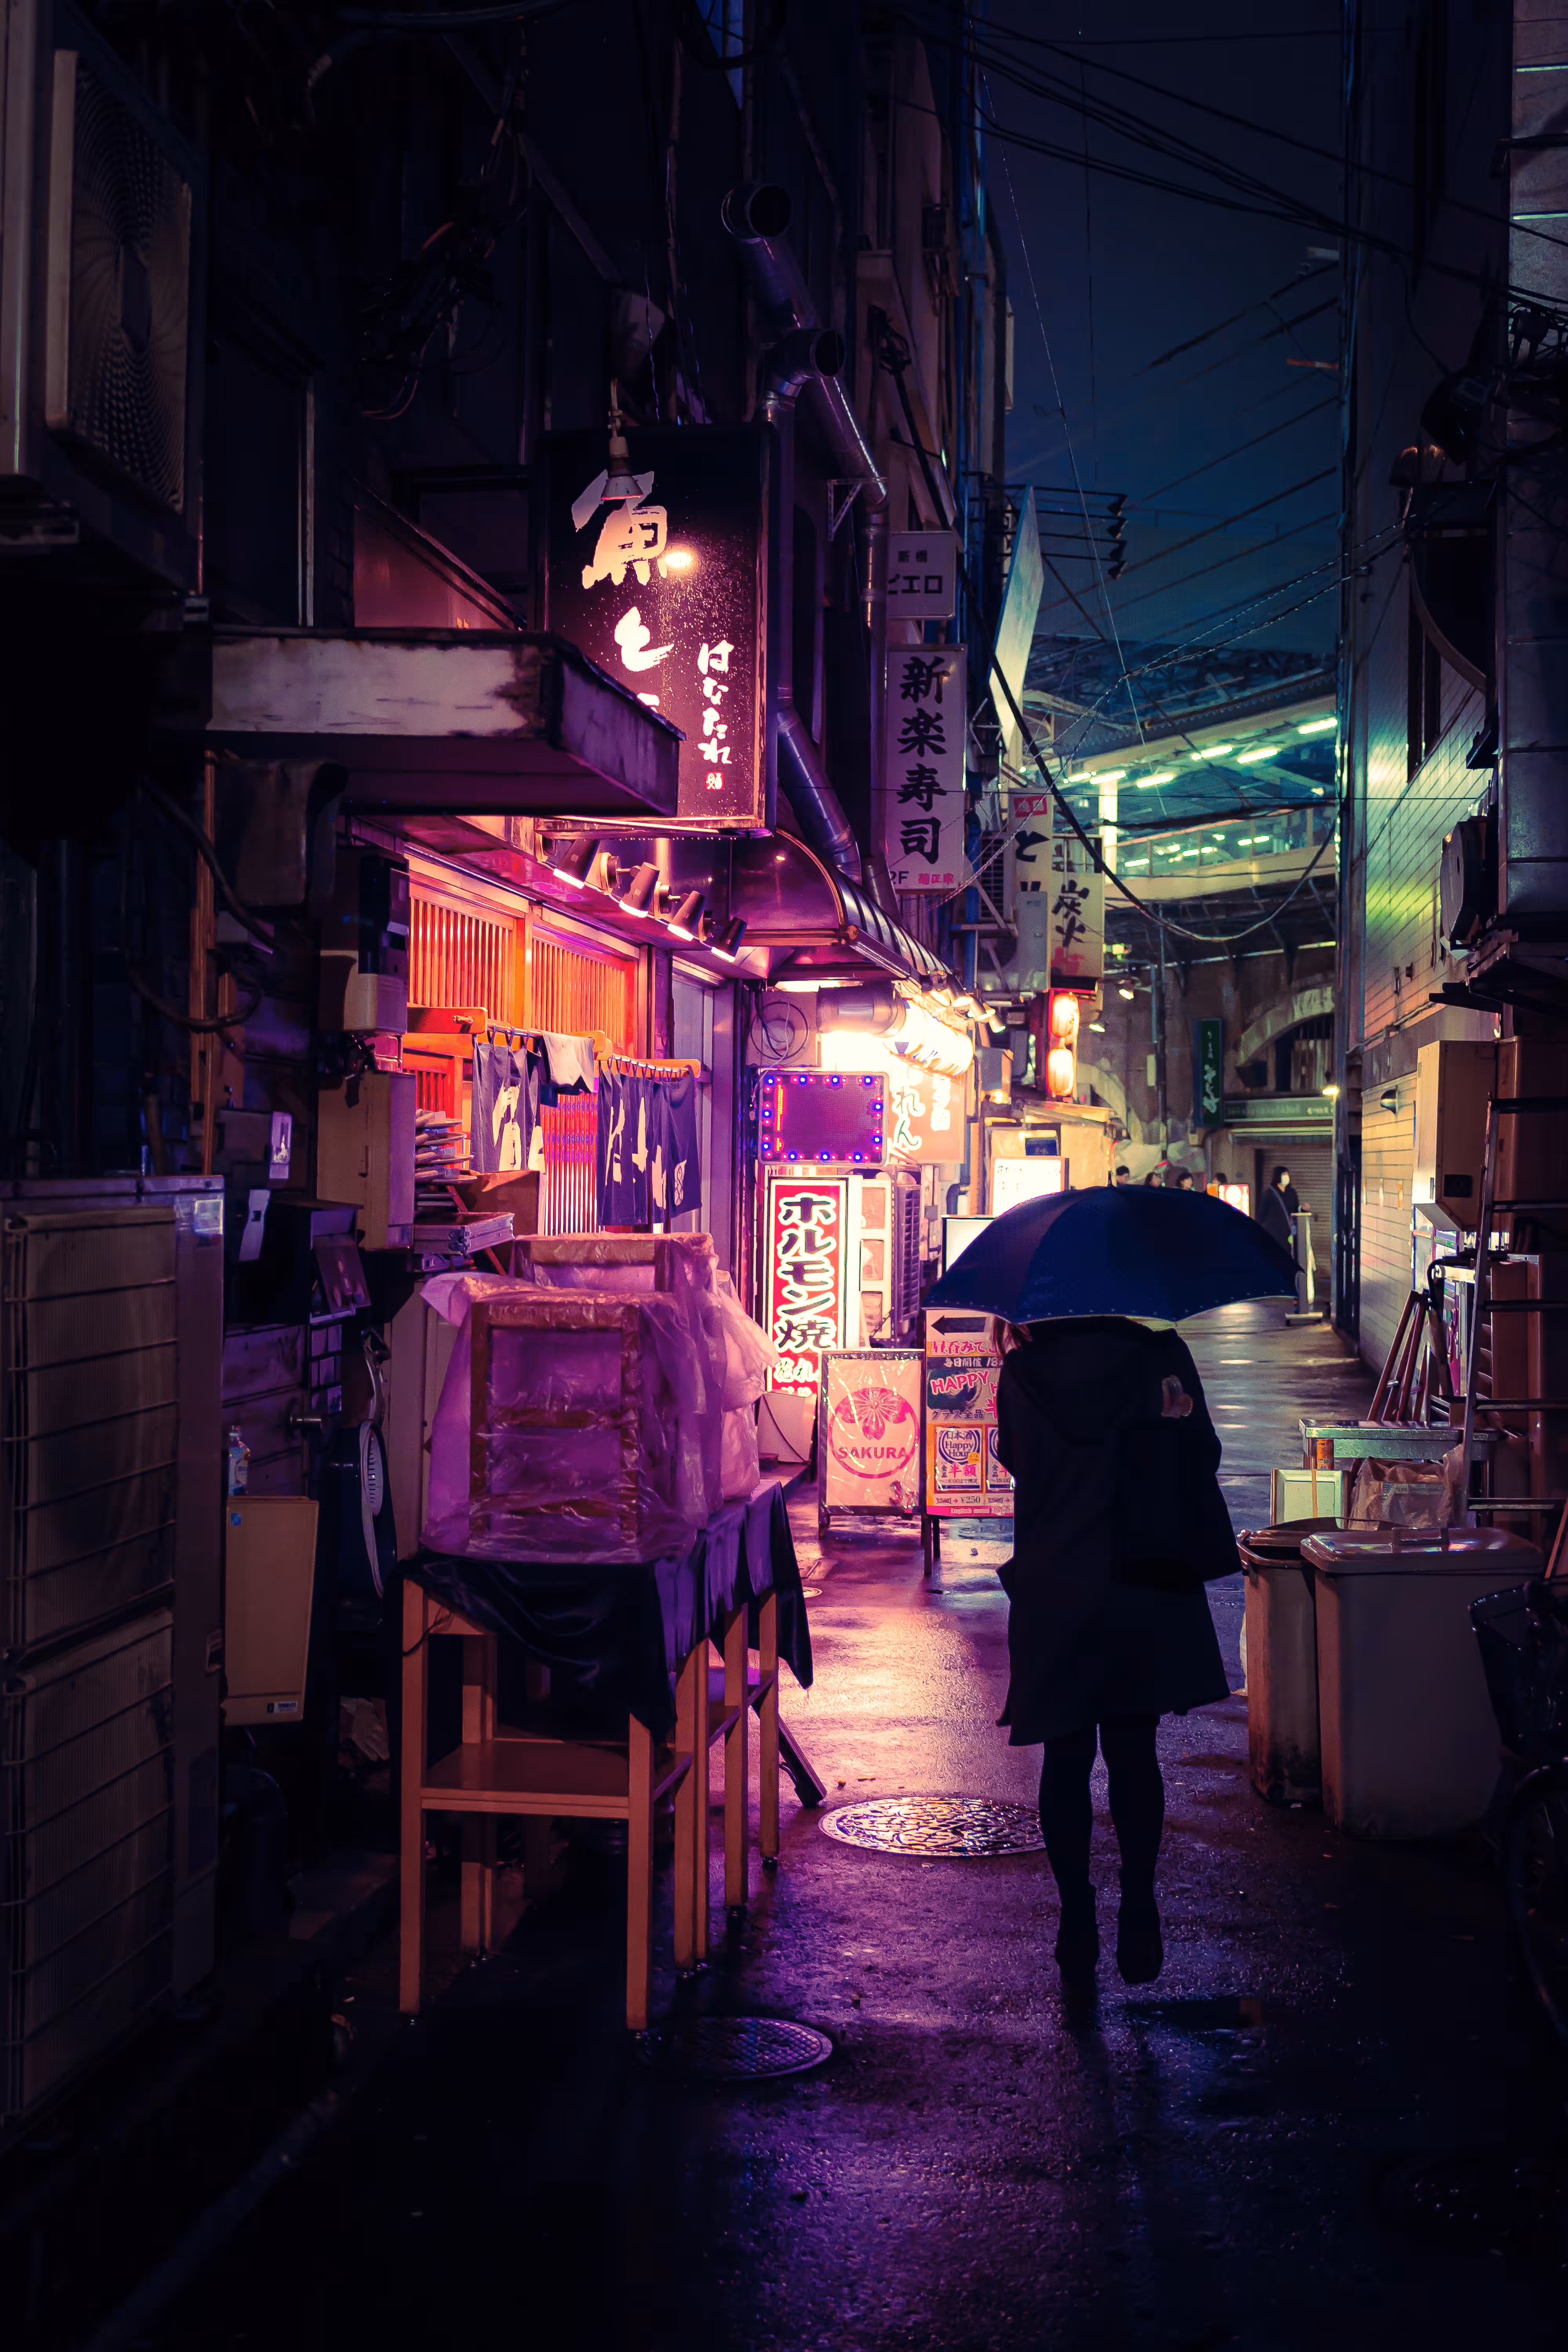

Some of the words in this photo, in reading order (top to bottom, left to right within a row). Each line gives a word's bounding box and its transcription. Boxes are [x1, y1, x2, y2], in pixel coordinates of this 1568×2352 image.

[896, 656, 947, 865] 新楽寿司
[1052, 879, 1089, 948] 炭火
[778, 1194, 836, 1351] ホルモン焼
[931, 1371, 989, 1394] HAPPY
[932, 1409, 984, 1419] グラス全品
[838, 1446, 910, 1459] SAKURA
[945, 1440, 974, 1451] Happy
